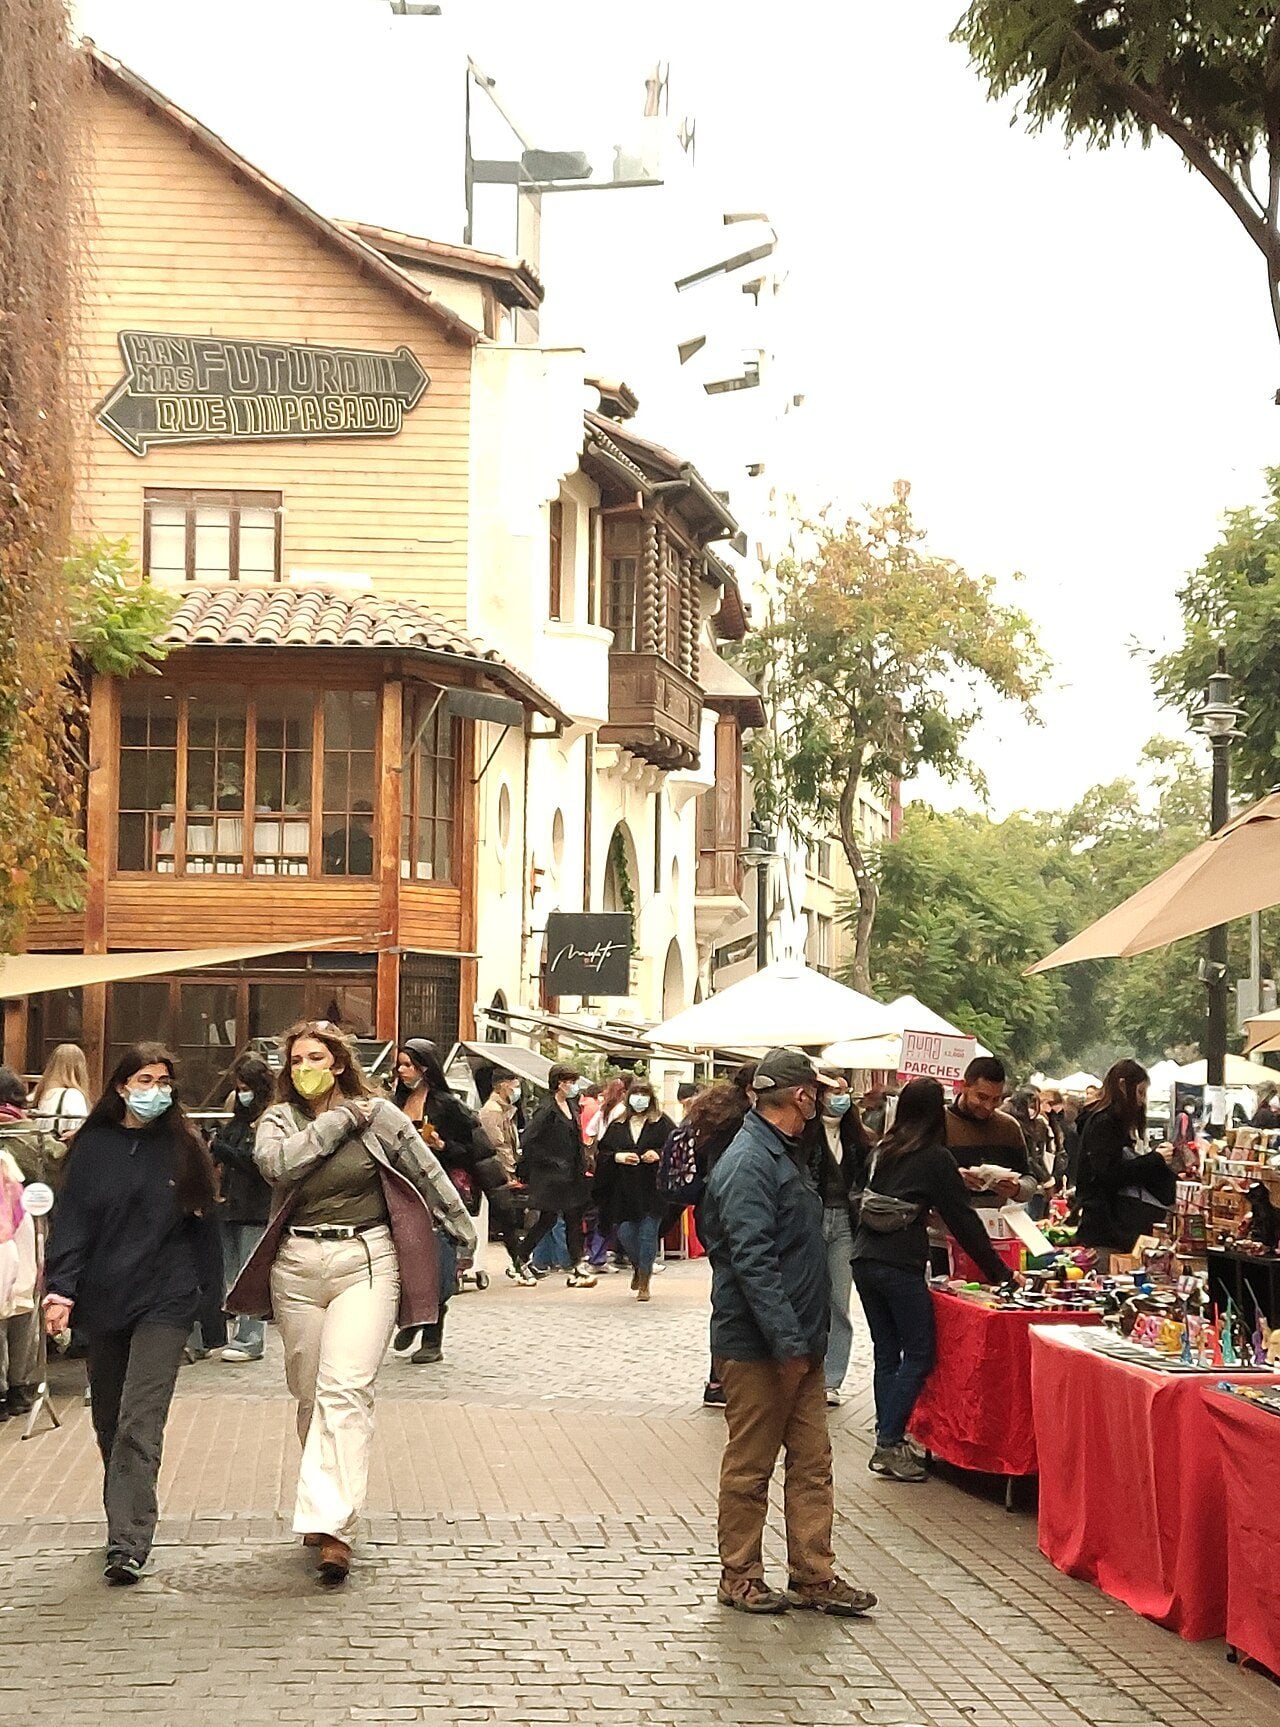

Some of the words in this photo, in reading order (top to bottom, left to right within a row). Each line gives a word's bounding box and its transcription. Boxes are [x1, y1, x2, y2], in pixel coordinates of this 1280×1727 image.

[129, 336, 192, 366] HAY
[135, 363, 196, 392] MAS
[156, 398, 229, 432] QUE
[282, 395, 399, 430] PASADO
[904, 1061, 961, 1078] PARCHES
